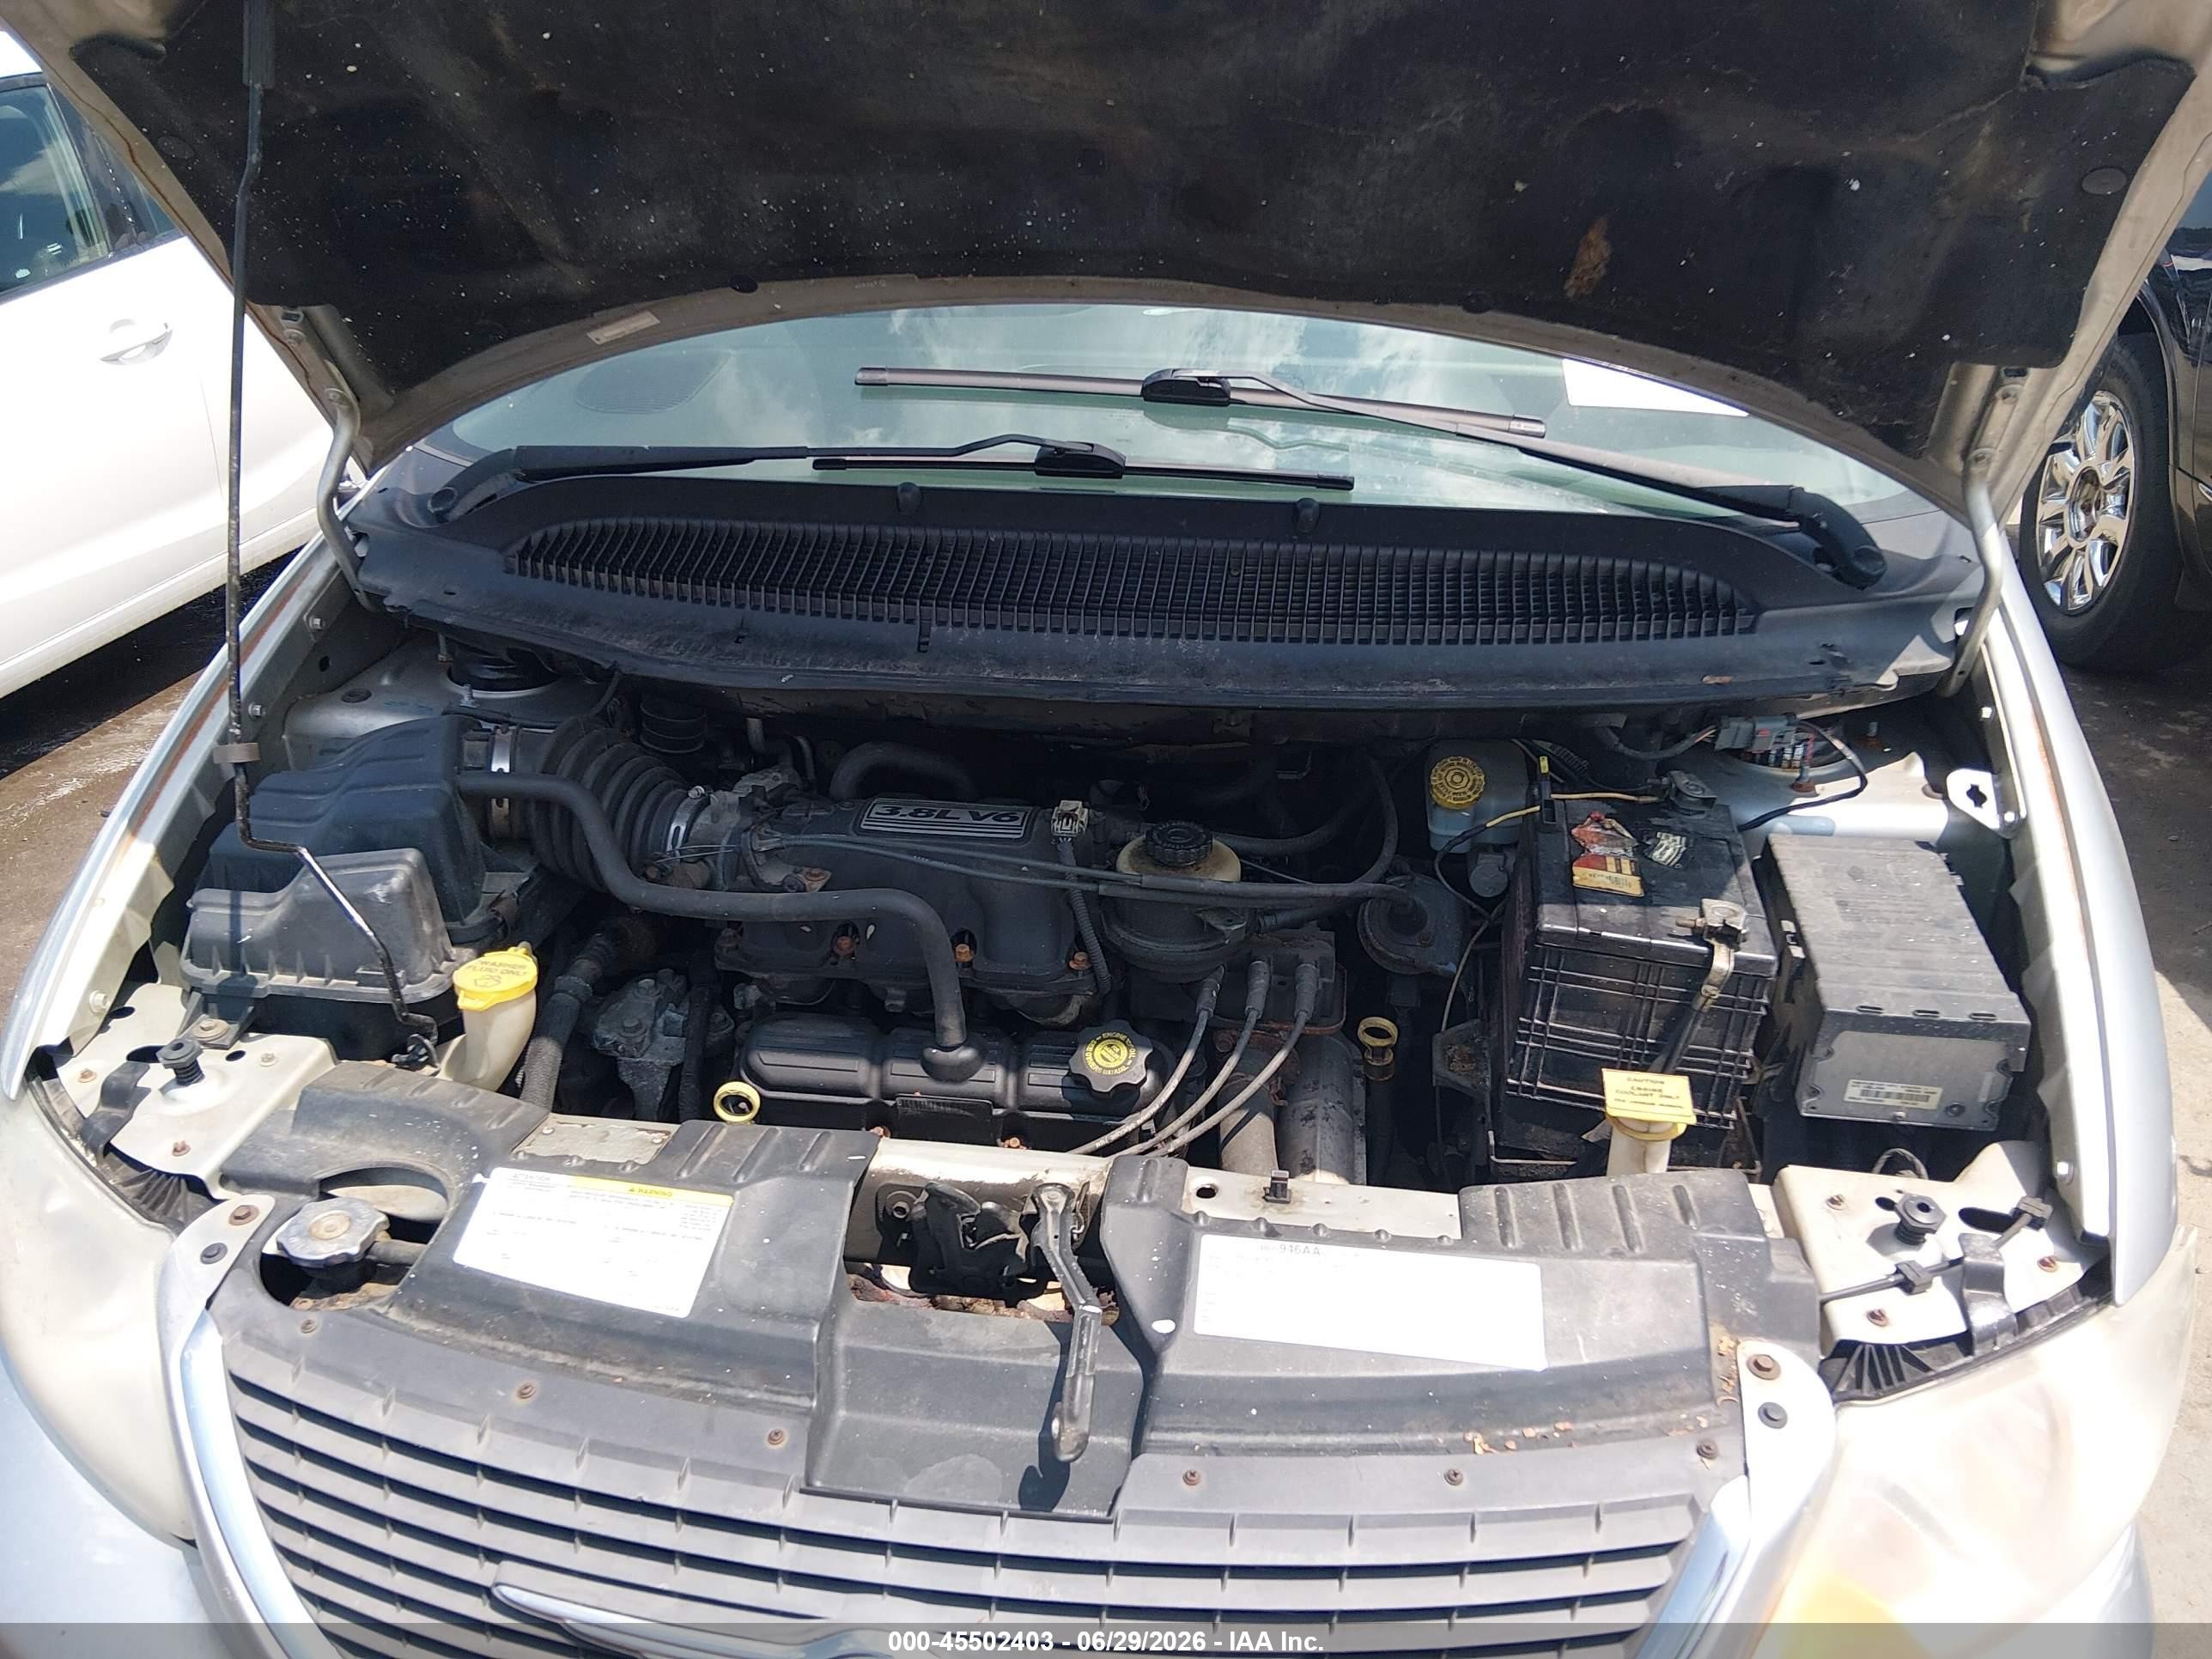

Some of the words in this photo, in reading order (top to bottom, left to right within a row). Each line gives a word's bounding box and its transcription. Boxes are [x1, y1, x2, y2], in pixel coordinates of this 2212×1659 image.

[875, 805, 960, 821] 3.8L
[968, 811, 1020, 823] V6
[500, 968, 529, 976] ONLY
[1128, 1048, 1137, 1059] OIL
